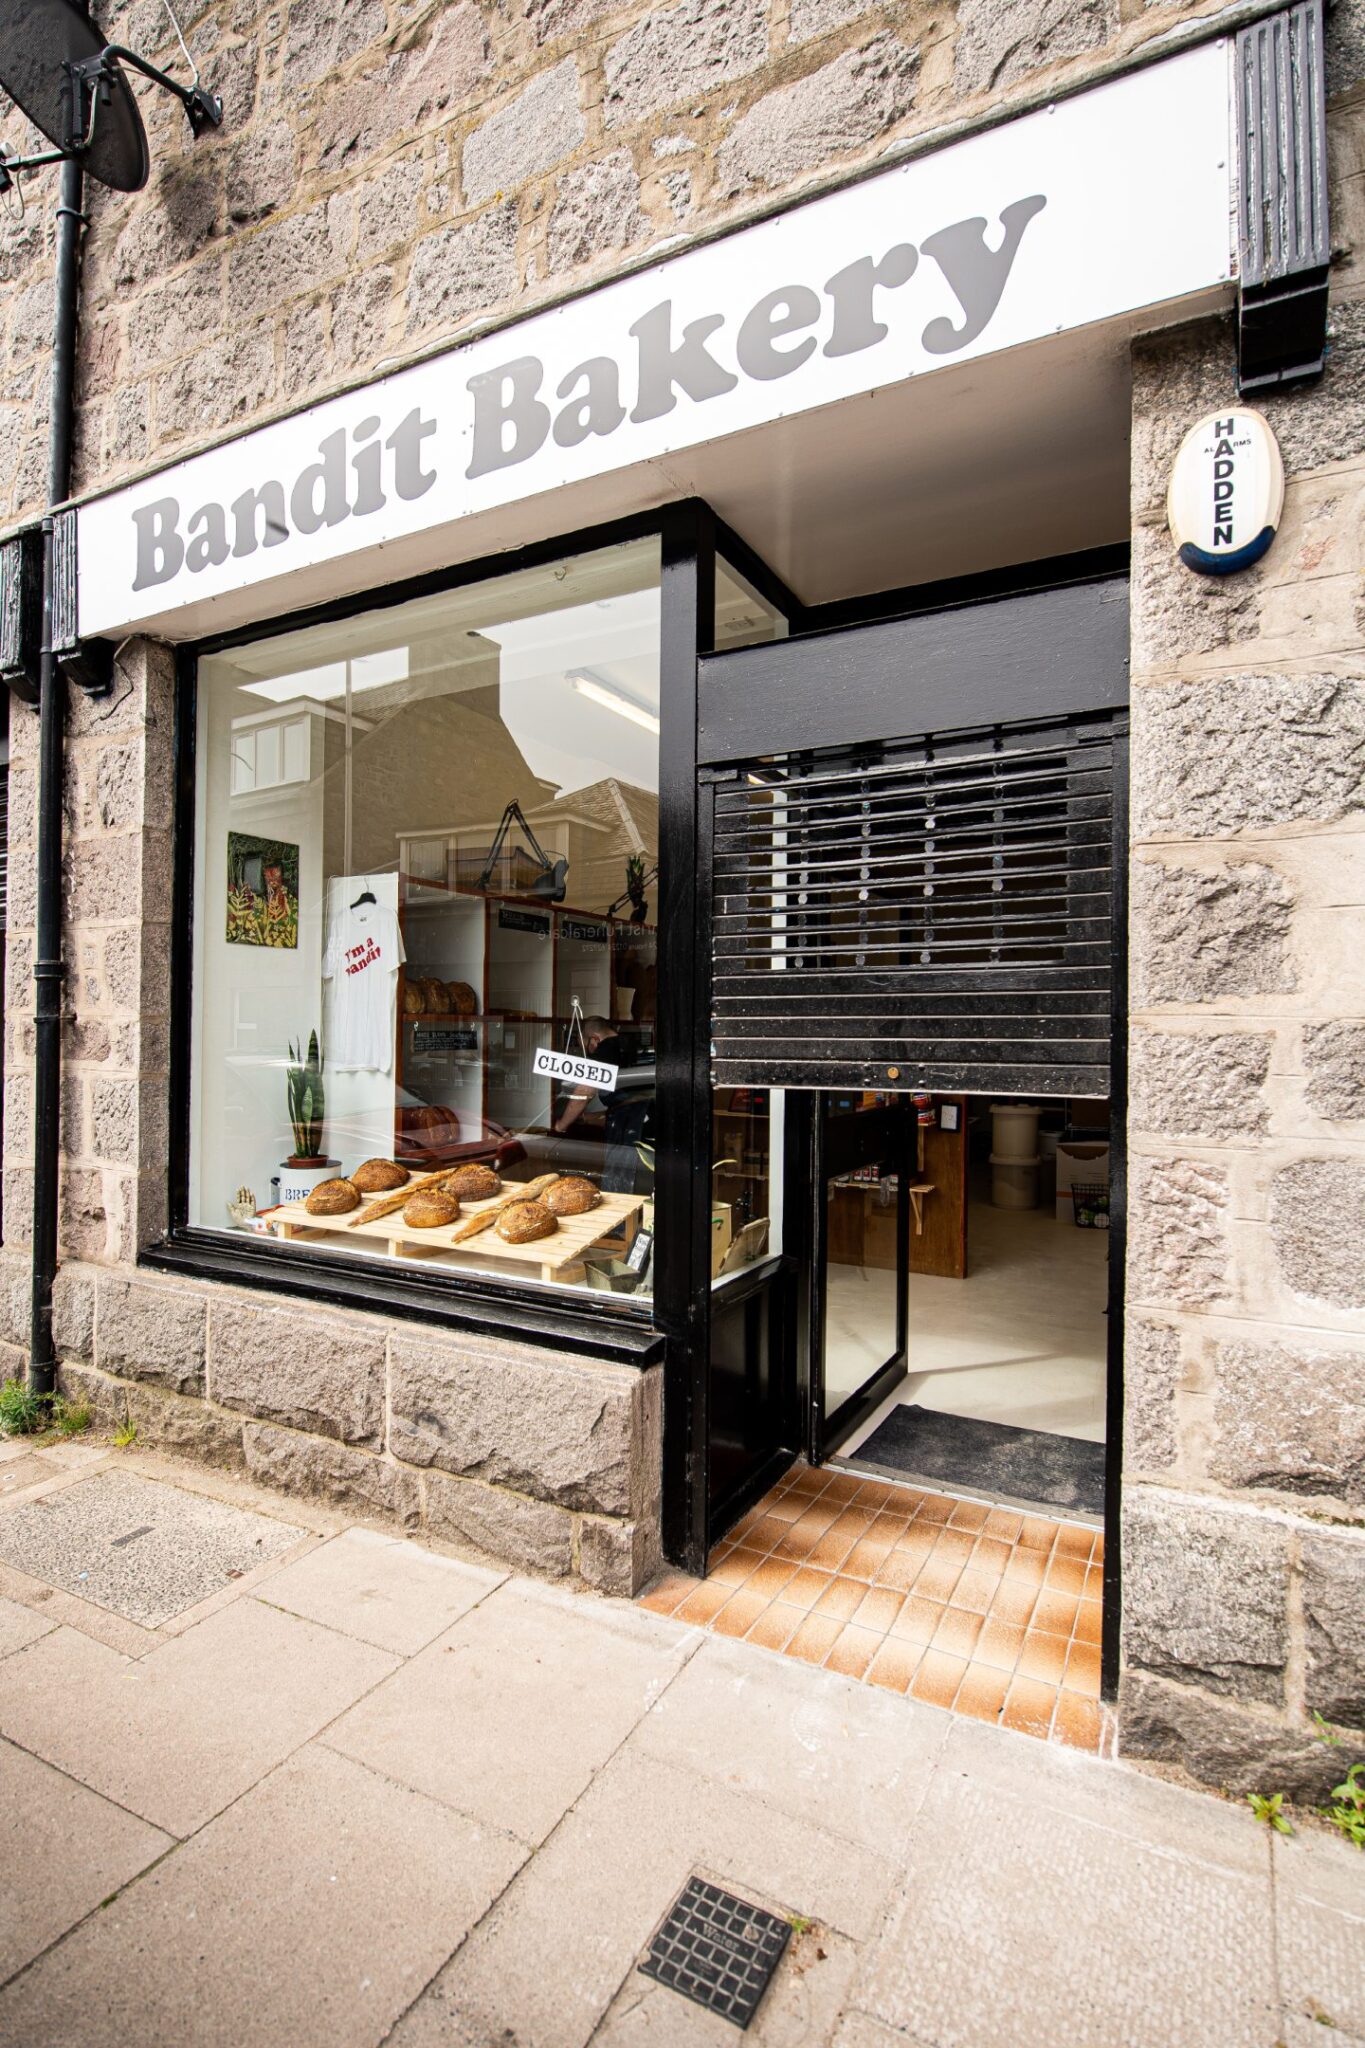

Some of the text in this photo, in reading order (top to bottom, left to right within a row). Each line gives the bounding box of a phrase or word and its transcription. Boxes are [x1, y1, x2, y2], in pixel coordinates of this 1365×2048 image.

[131, 194, 1048, 592] Bandit Bakery
[1213, 418, 1235, 547] HADDEN
[366, 937, 374, 948] a
[537, 1055, 613, 1084] CLOSED
[703, 1922, 740, 1952] Water
